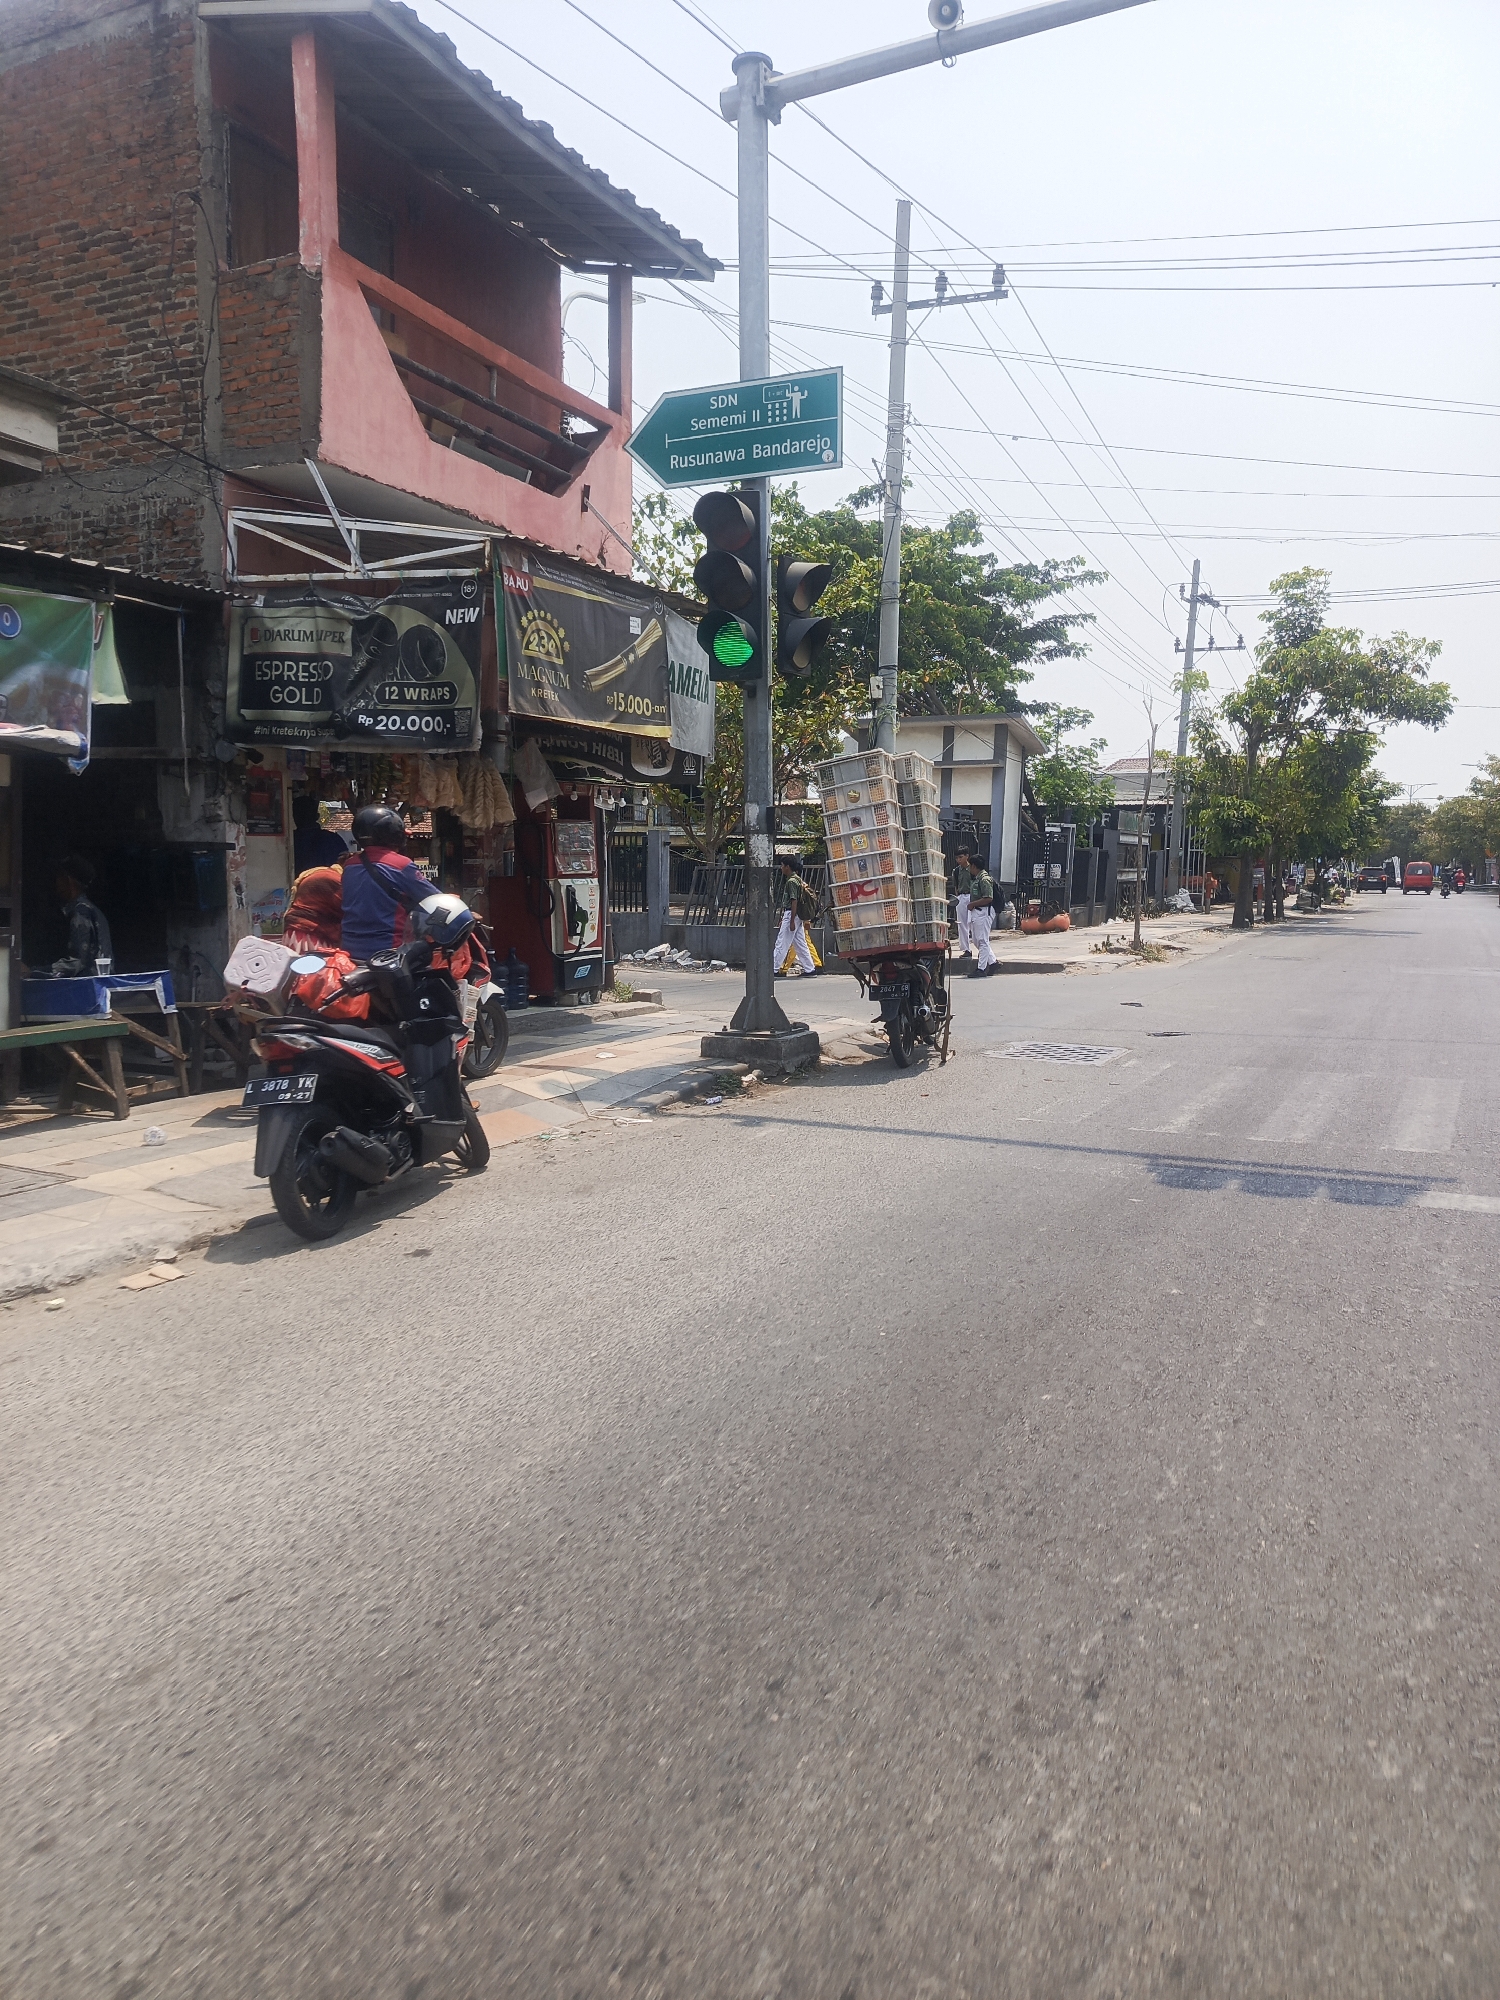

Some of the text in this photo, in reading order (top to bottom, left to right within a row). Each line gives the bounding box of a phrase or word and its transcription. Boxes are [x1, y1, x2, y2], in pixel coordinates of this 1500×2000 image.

[709, 393, 738, 410] SDN
[690, 409, 760, 431] Sememi II
[670, 433, 831, 470] Rusunawa Bandarejo
[463, 585, 476, 593] 18+
[503, 572, 530, 592] BARU
[445, 607, 480, 625] NEW
[263, 628, 315, 643] DJARUM
[528, 631, 558, 657] 234
[255, 660, 334, 683] ESPRESSO
[516, 661, 571, 690] MAGNUM
[269, 685, 323, 706] GOLD
[384, 685, 451, 701] 12 WRAPS
[531, 687, 560, 703] KRETEK
[357, 714, 374, 726] Rp
[253, 725, 270, 735] #Ini
[271, 726, 317, 740] Kreteknya
[246, 1077, 314, 1094] L 3878 YK
[277, 1091, 310, 1100] 09-27
